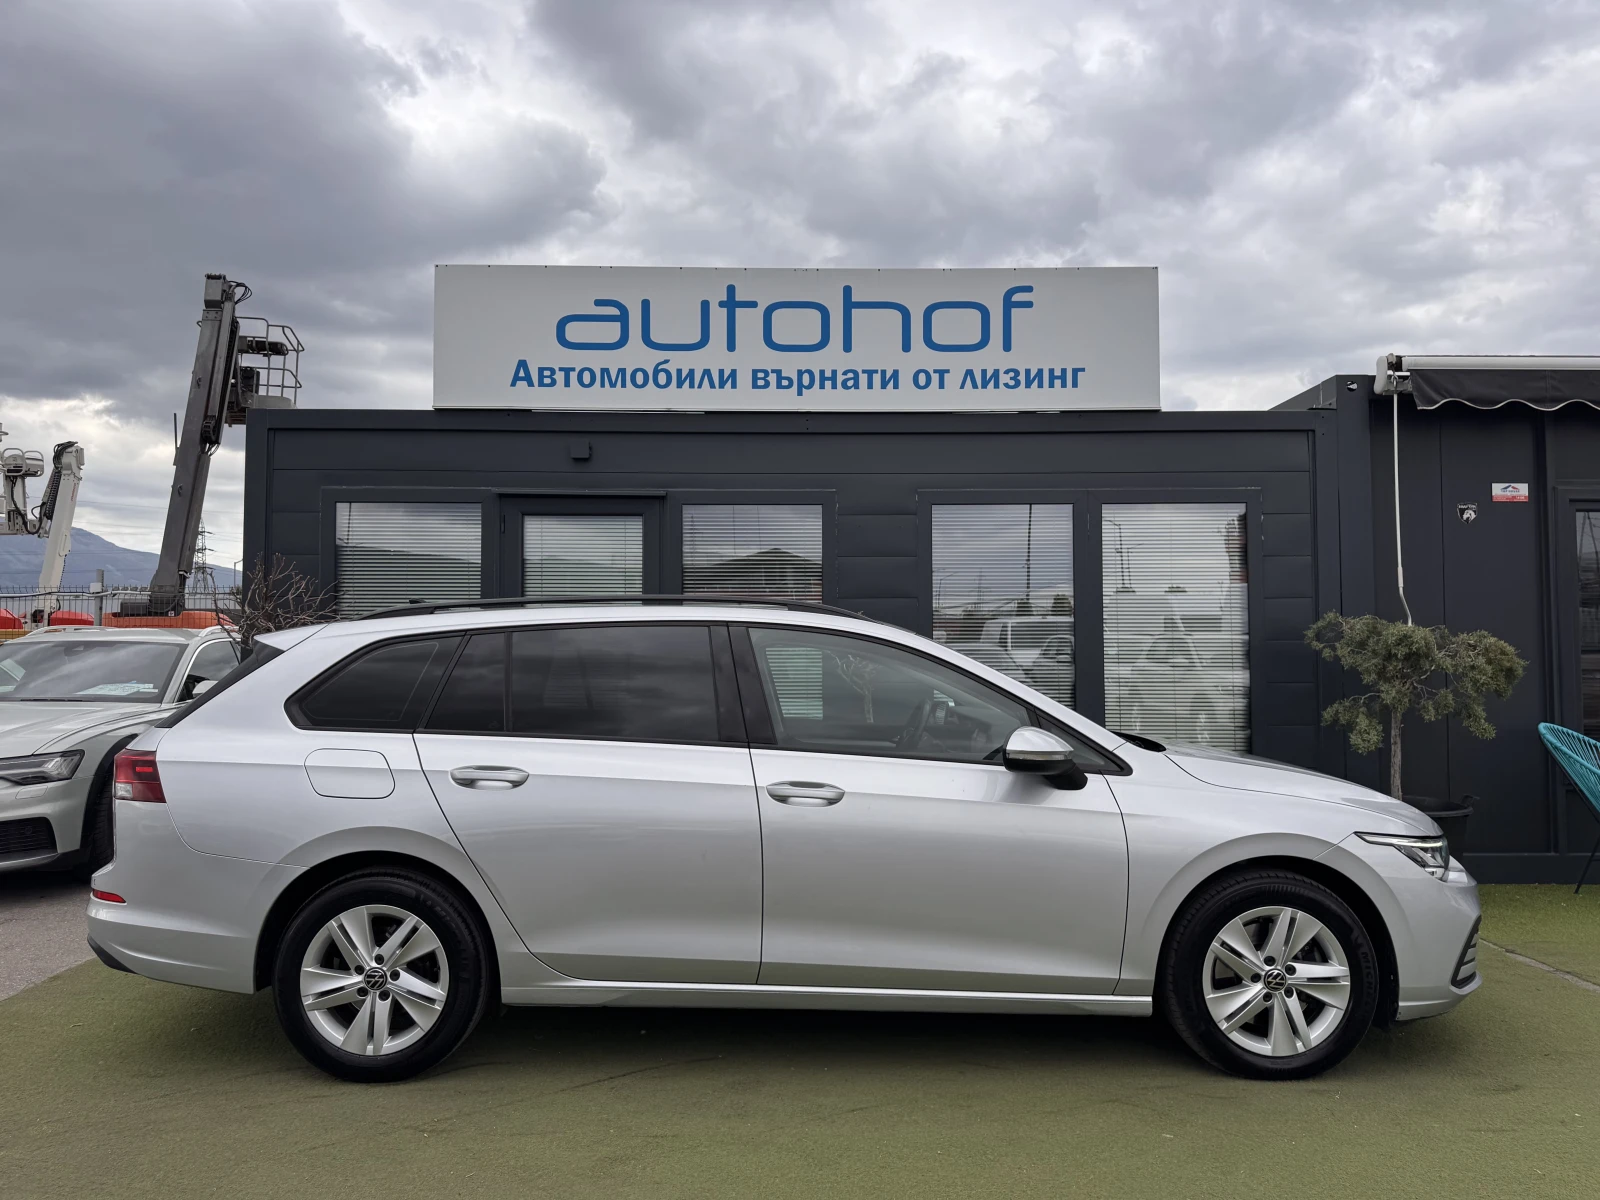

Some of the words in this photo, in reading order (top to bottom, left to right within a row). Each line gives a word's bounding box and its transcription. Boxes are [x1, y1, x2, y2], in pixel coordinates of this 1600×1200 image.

[555, 284, 1034, 353] autohof
[510, 359, 738, 390] Автомобили
[751, 368, 900, 397] върнати
[912, 368, 951, 391] от
[960, 367, 1086, 390] лизинг
